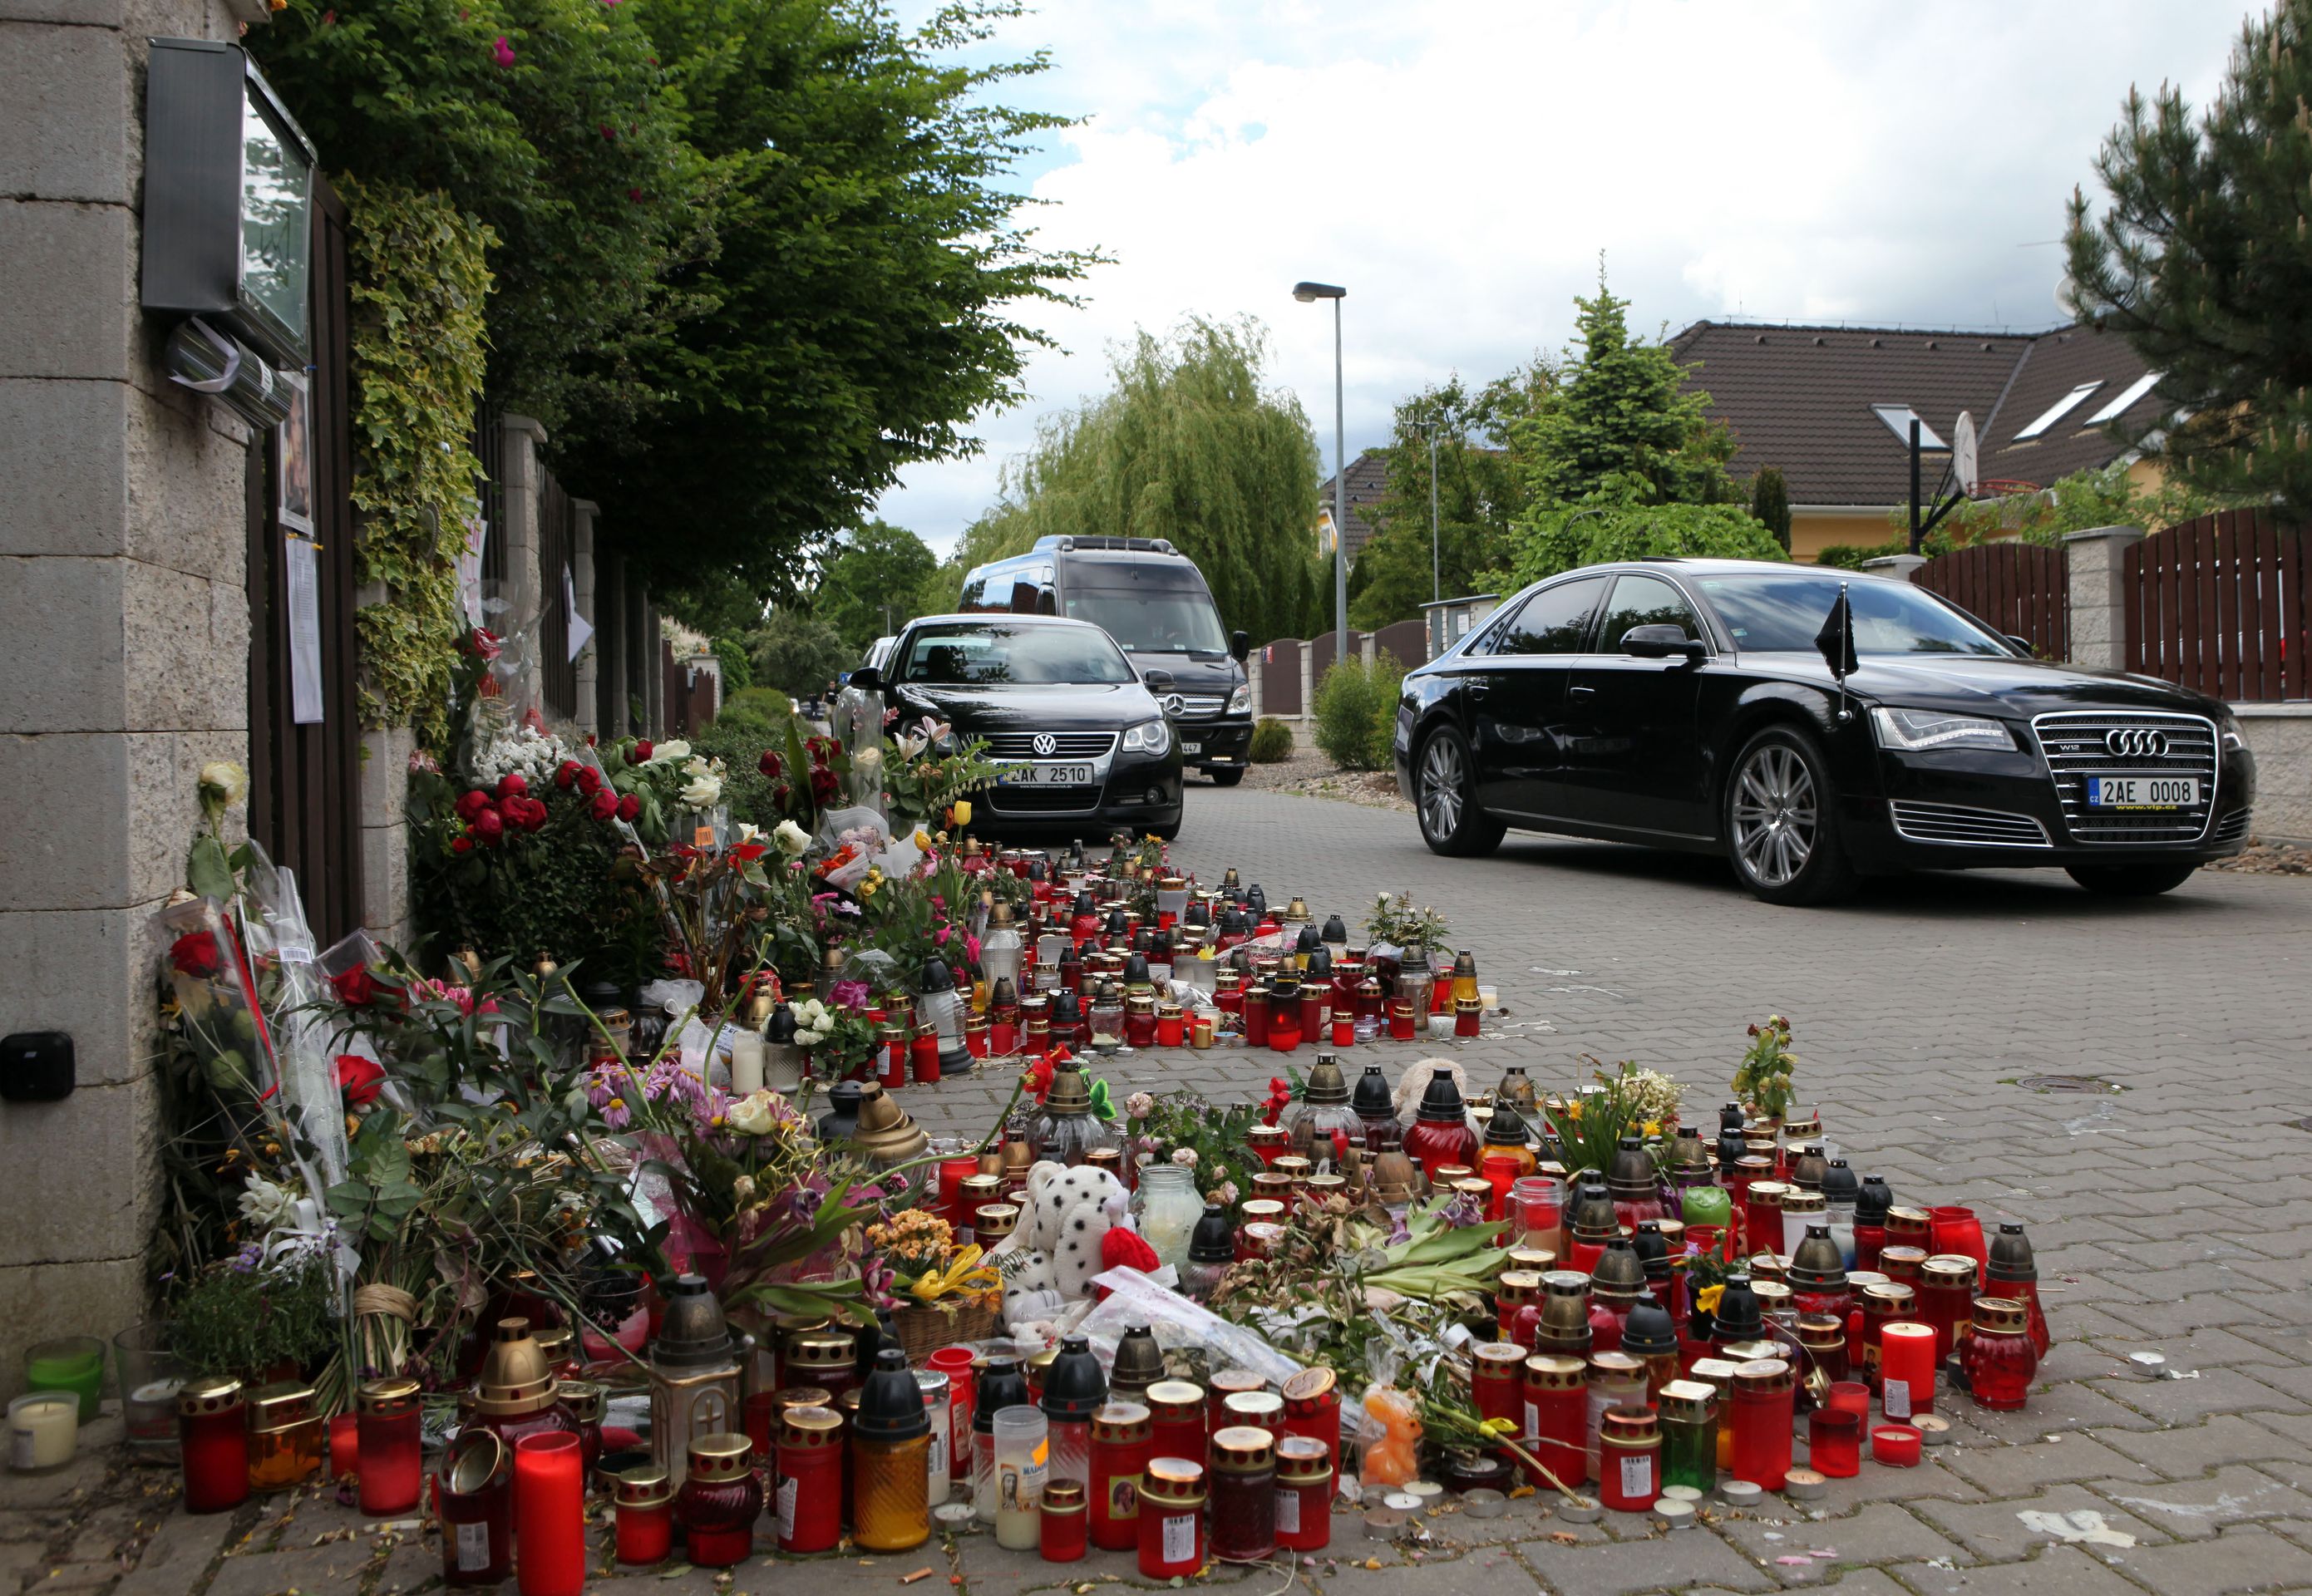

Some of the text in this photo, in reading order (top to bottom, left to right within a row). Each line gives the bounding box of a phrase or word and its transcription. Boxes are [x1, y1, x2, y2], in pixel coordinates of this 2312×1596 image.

[1050, 767, 1086, 782] 2510
[2103, 781, 2191, 803] 2AE 0008
